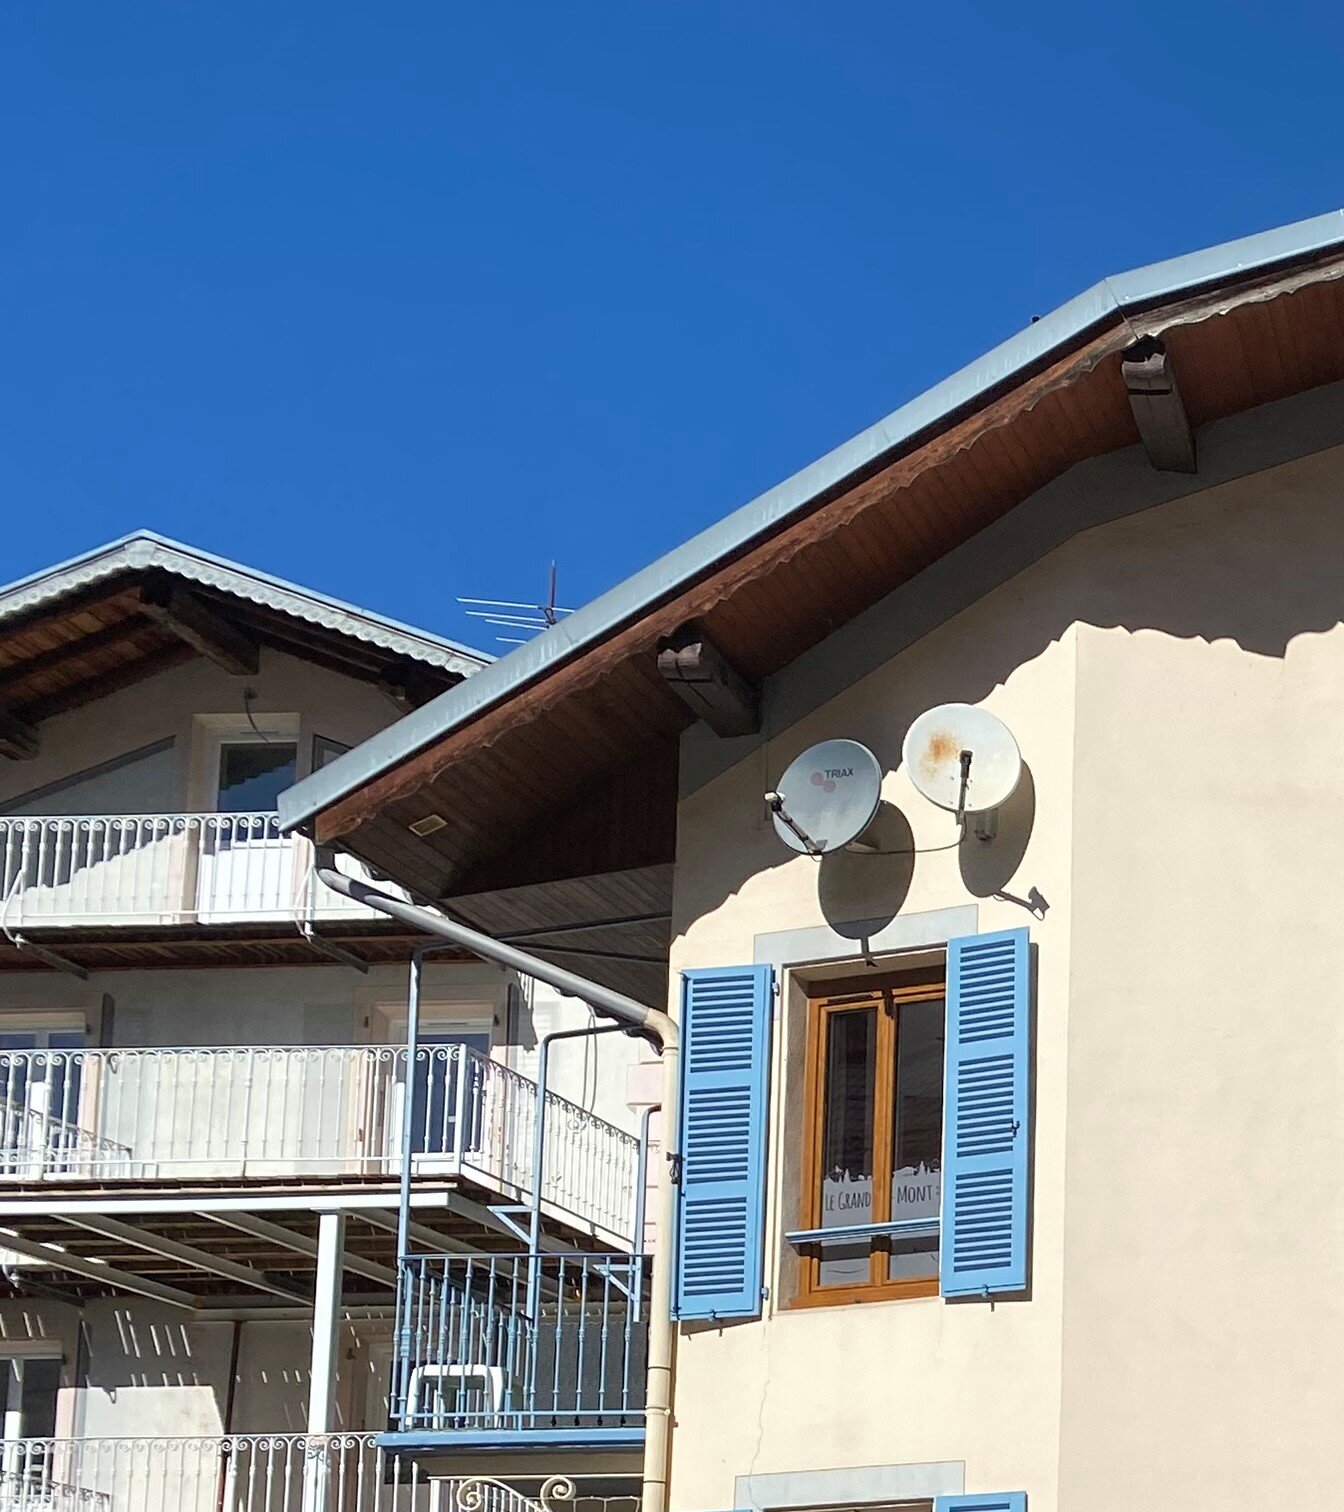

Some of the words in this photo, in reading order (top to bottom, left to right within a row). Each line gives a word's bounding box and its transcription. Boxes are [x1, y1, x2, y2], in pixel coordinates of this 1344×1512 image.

[824, 767, 854, 779] TRIAX
[825, 1193, 835, 1211] LE
[838, 1192, 870, 1210] GRAND
[898, 1185, 932, 1204] MONT
